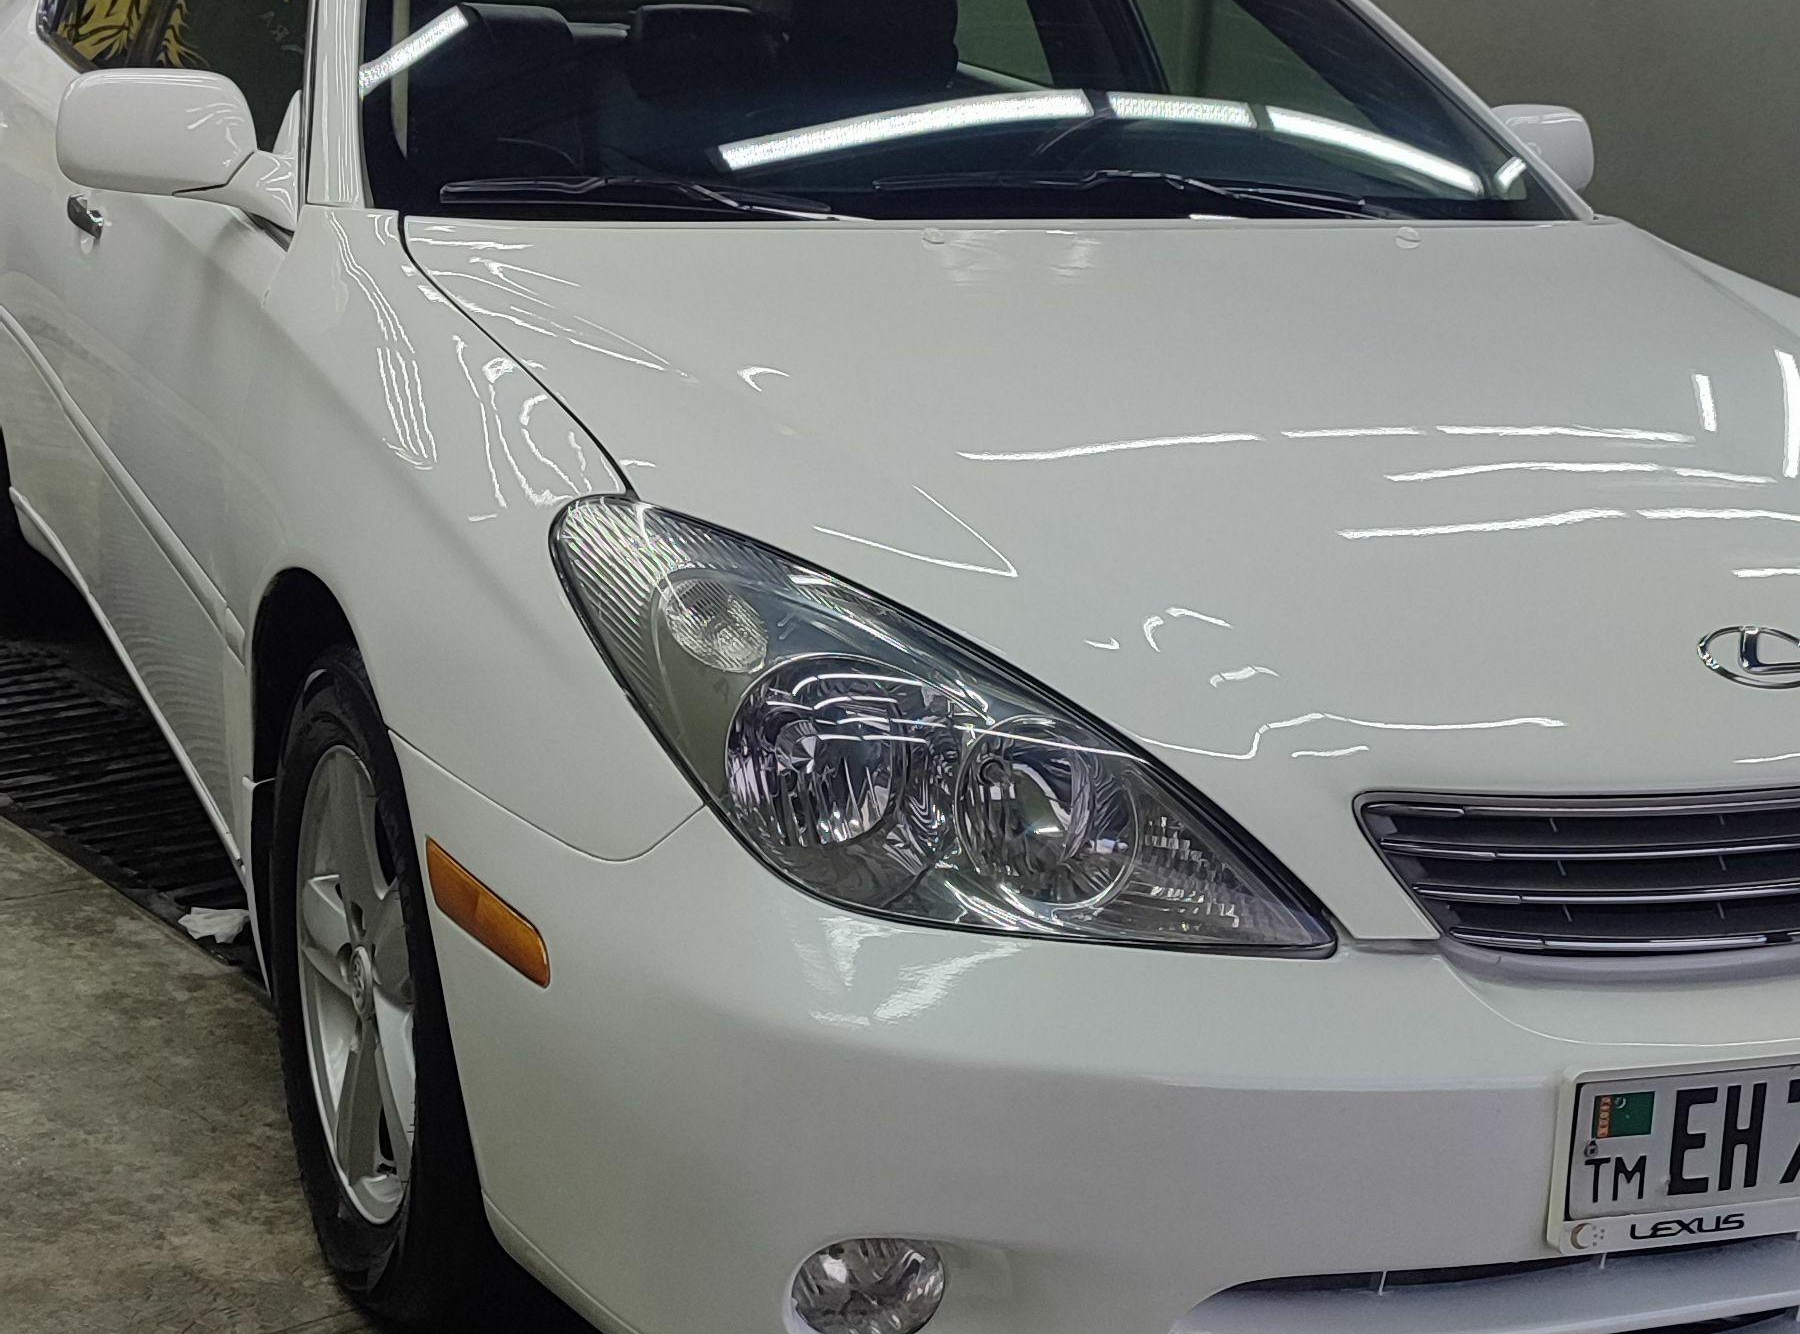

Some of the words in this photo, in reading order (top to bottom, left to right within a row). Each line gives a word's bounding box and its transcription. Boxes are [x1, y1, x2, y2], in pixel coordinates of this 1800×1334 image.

[1585, 1155, 1647, 1203] TM
[1667, 1082, 1767, 1196] EH
[1630, 1213, 1744, 1240] LEXUS
